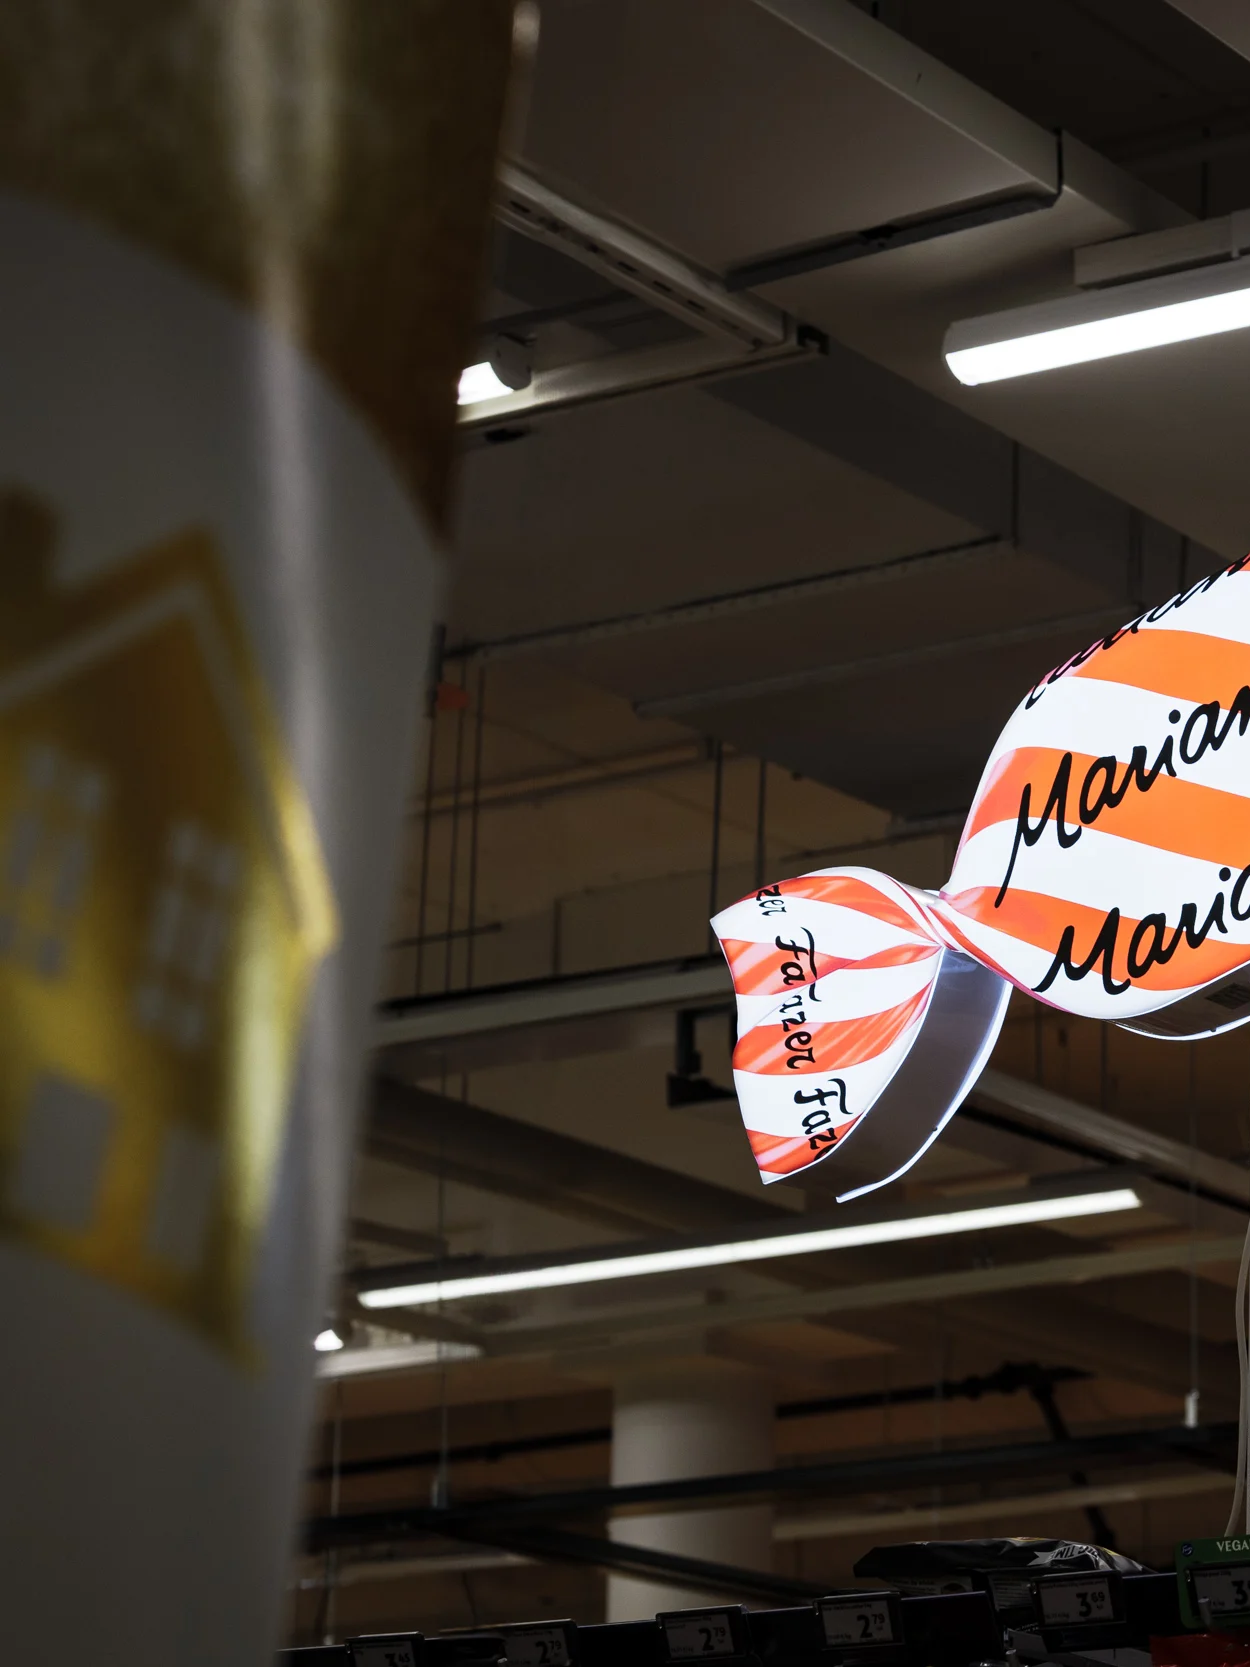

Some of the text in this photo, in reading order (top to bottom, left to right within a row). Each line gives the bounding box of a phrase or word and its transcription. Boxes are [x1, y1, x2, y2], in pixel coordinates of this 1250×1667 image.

[1232, 1580, 1247, 1605] 3
[1075, 1592, 1092, 1617] 3
[857, 1615, 873, 1638] 2
[698, 1628, 714, 1651] 2
[536, 1641, 550, 1664] 2
